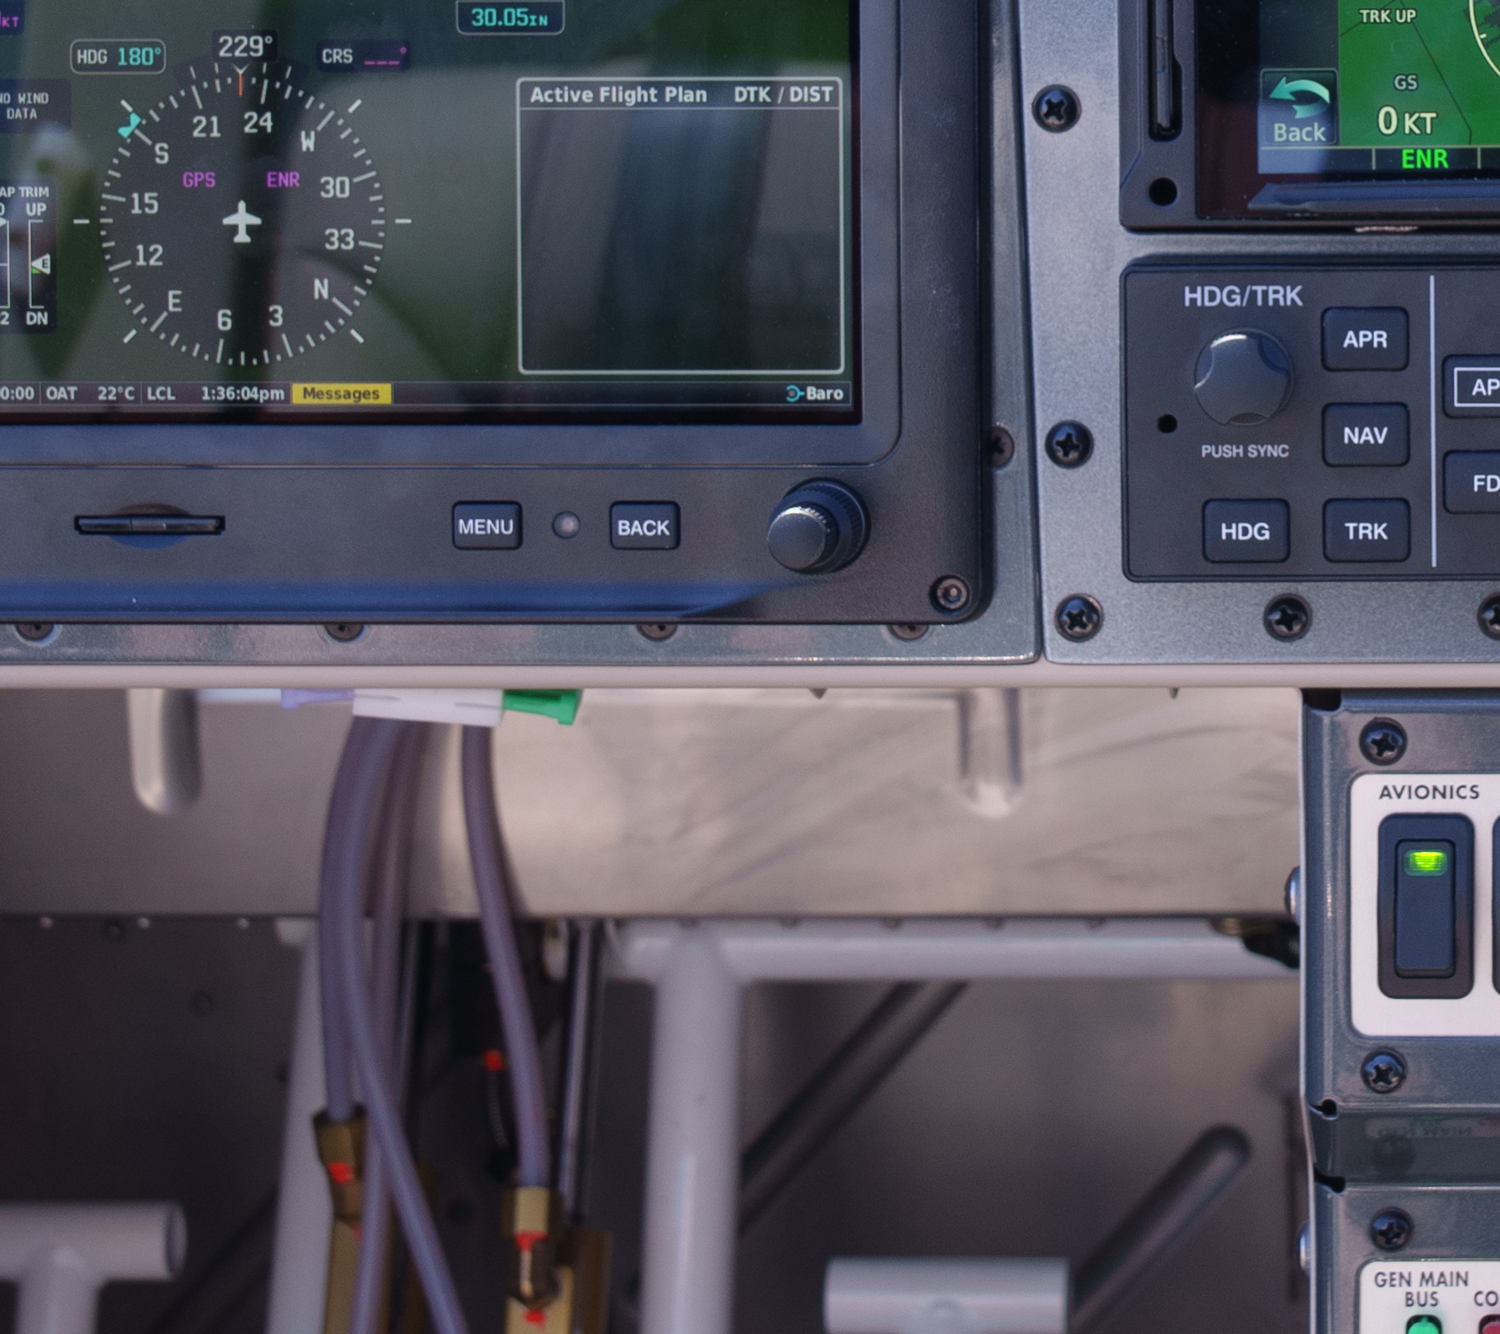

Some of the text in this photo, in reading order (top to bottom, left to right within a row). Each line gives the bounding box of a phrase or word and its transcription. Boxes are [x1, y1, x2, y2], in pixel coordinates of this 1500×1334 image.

[531, 86, 707, 106] Active Flight Plan
[1274, 123, 1325, 141] Back
[1402, 149, 1448, 168] ENR
[1185, 286, 1303, 306] HDG/TRK
[1343, 331, 1387, 348] APR
[302, 387, 380, 403] Messages
[459, 519, 513, 534] MENU
[618, 520, 669, 536] BACK
[1379, 785, 1479, 799] AVIONICS
